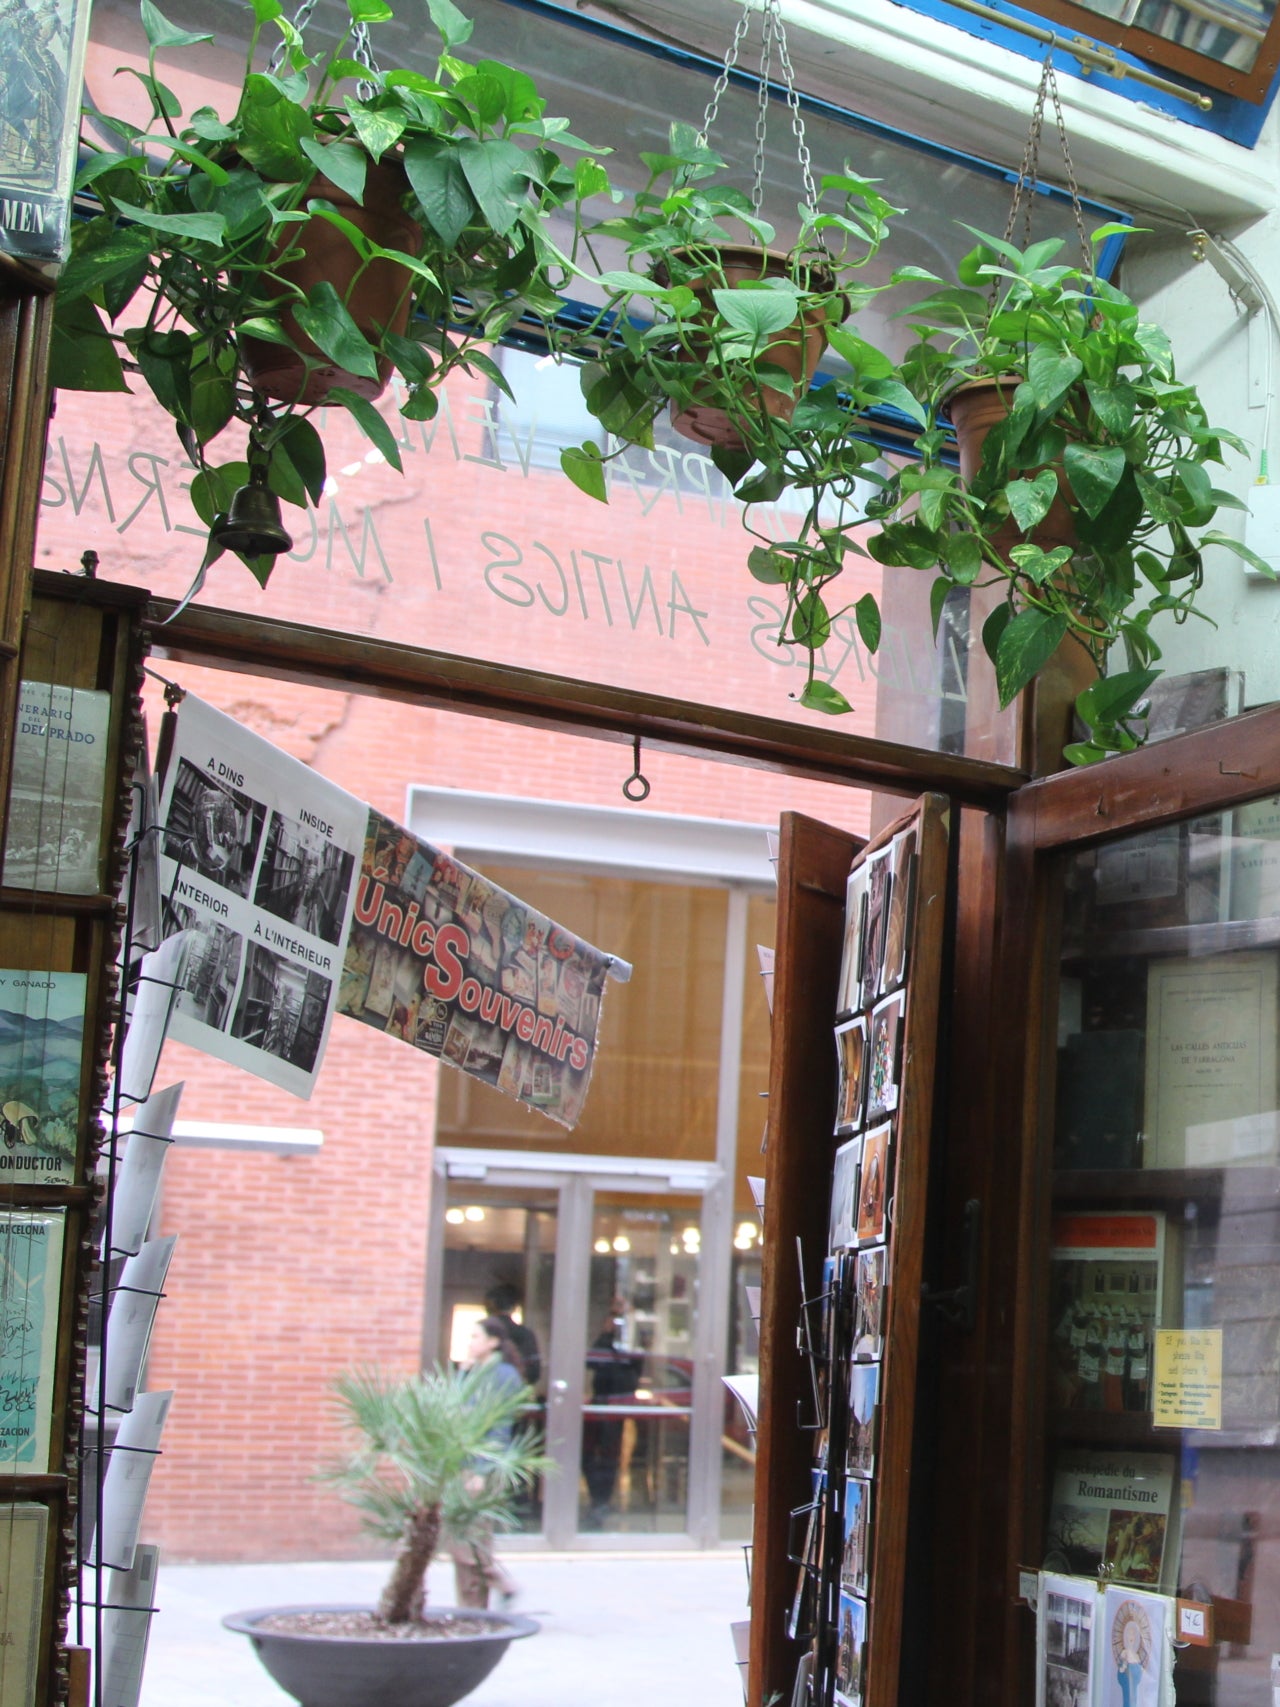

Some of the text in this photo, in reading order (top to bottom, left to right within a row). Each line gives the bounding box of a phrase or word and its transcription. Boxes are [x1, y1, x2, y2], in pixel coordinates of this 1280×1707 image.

[21, 722, 95, 744] DEL PRADO
[207, 757, 245, 788] A DINS
[300, 808, 334, 839] INSIDE
[254, 920, 332, 970] À L'INTÉRIEUR
[354, 866, 588, 1071] Únic Souvenirs
[13, 979, 56, 989] GANADO
[1181, 1055, 1236, 1065] DE TARRAGONA
[0, 1155, 62, 1171] ONDUCTOR
[0, 1225, 45, 1236] ARCELONA
[1123, 1465, 1136, 1479] du
[1078, 1480, 1159, 1504] Romantisme
